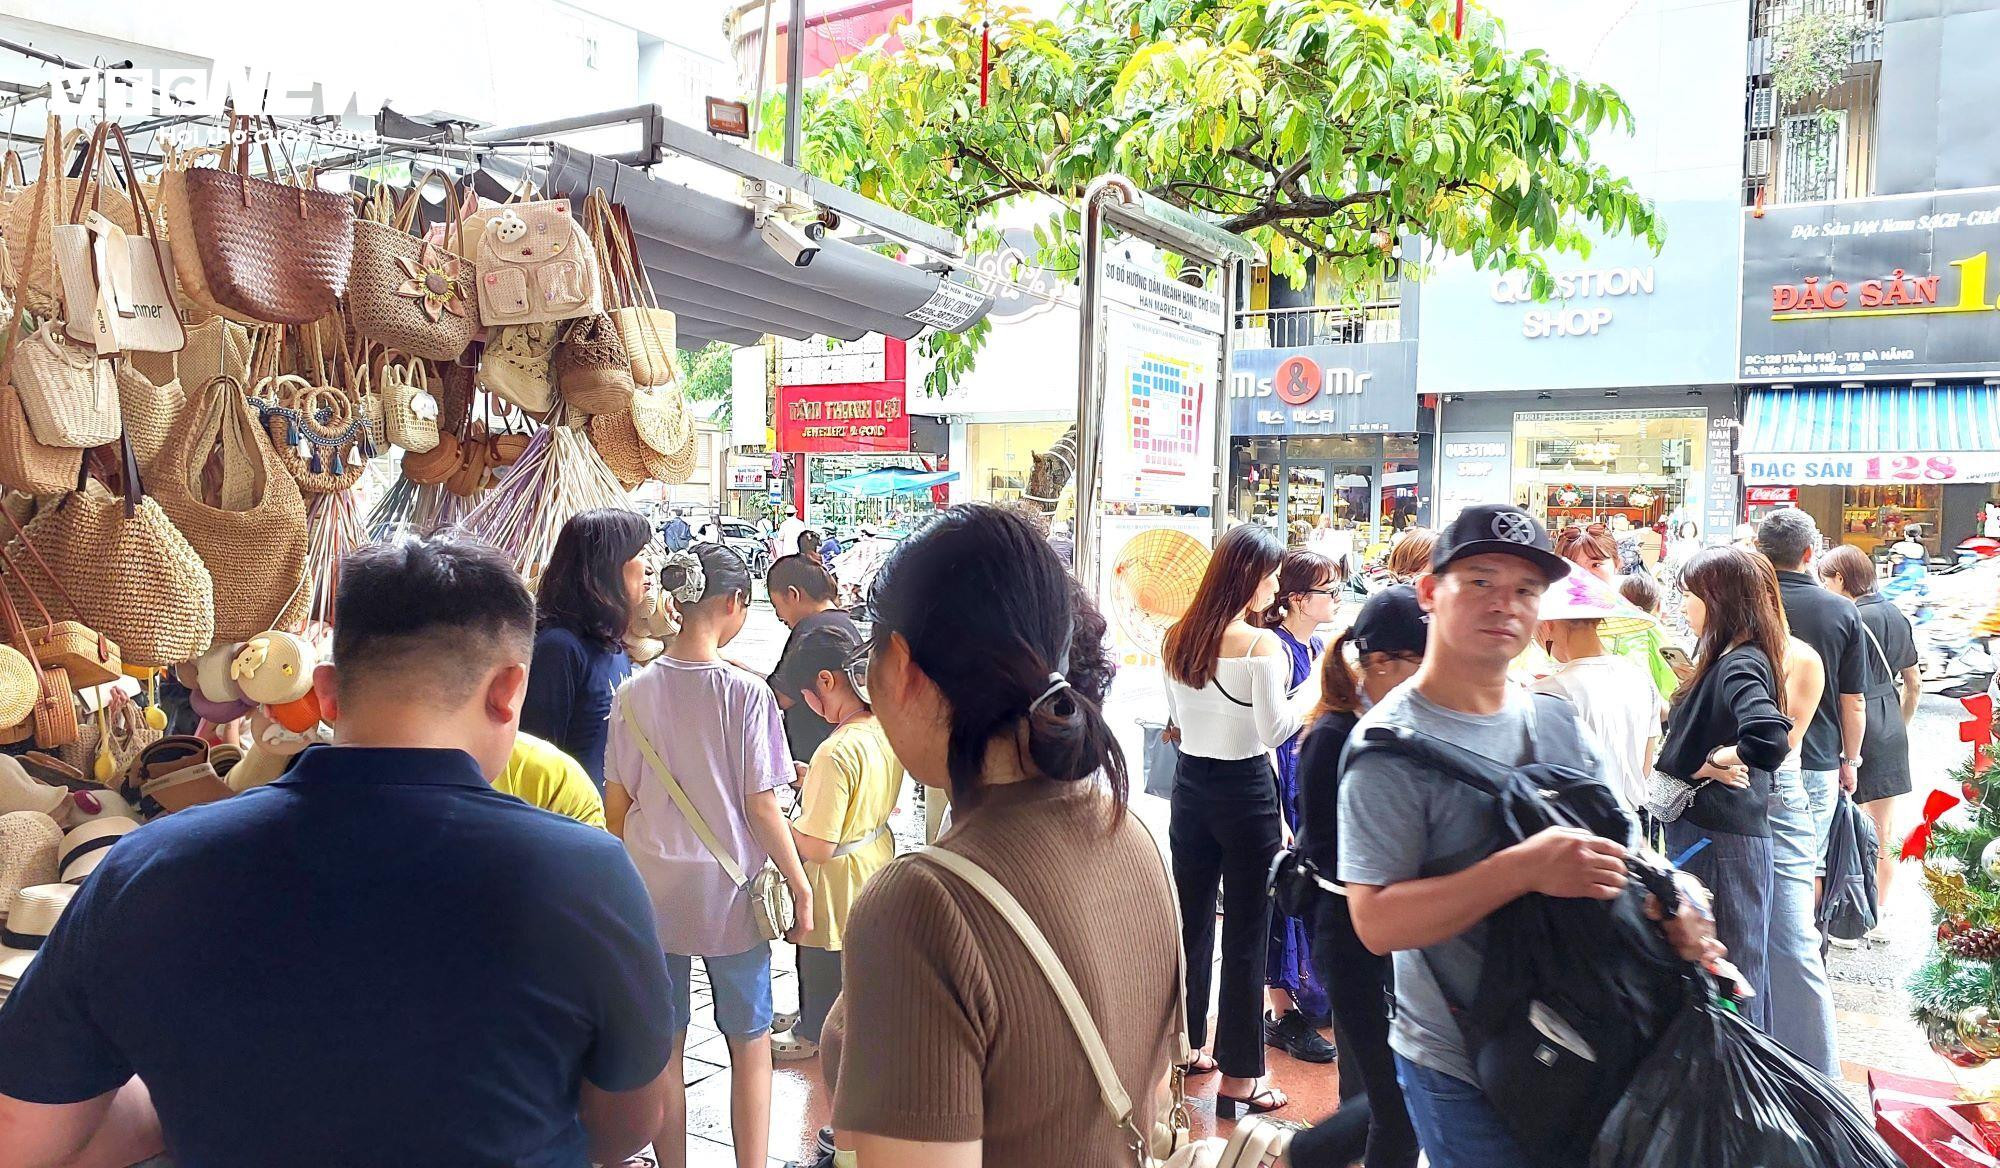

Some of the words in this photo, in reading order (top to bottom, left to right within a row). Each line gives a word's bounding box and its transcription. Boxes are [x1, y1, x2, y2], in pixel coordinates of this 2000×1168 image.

[1879, 218, 1916, 233] Nam
[1490, 265, 1655, 304] QUSTION
[1772, 277, 1849, 313] ĐẶC
[1860, 268, 1940, 307] SẢN
[1949, 251, 2000, 312] 1
[1140, 295, 1153, 309] HAN
[1154, 300, 1178, 318] MARKET
[1178, 307, 1193, 322] PLAN
[1522, 306, 1613, 338] SHOP
[1231, 371, 1272, 397] Ms
[1325, 367, 1373, 395] Mr
[1445, 443, 1506, 459] QUESTION
[1864, 456, 1958, 480] 128
